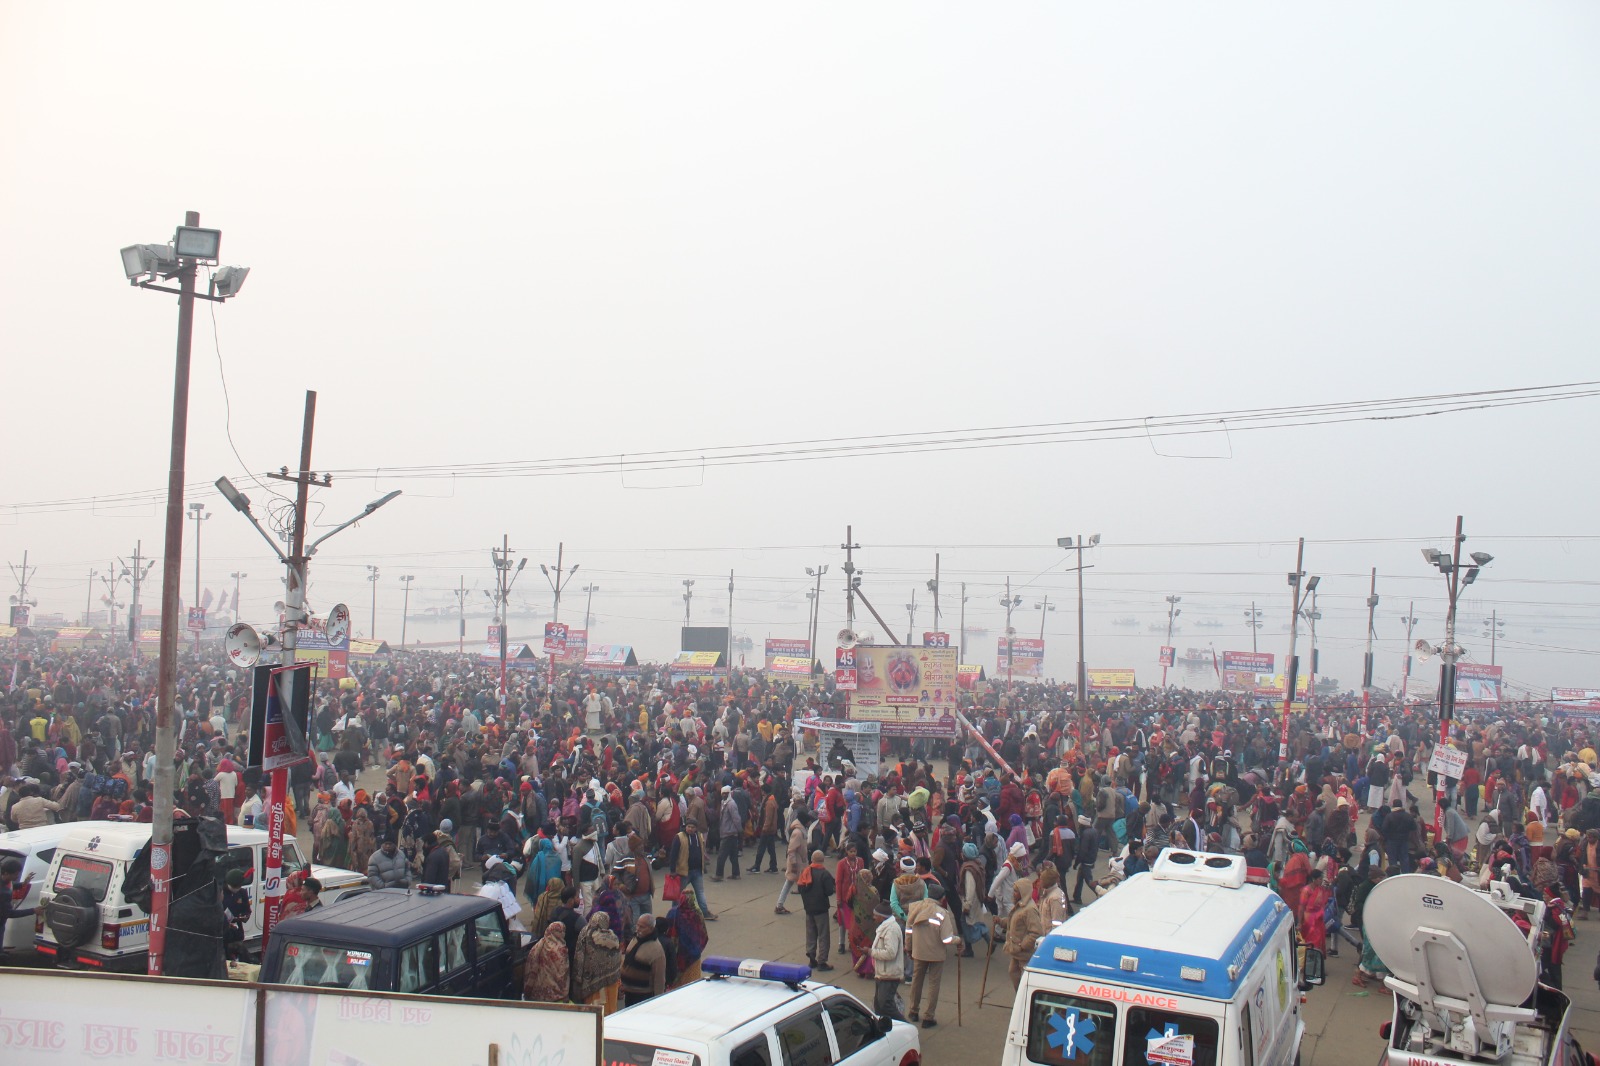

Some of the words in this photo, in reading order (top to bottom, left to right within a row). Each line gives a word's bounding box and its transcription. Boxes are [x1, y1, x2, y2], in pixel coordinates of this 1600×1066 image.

[550, 626, 565, 638] 32
[929, 635, 945, 647] 33
[839, 652, 853, 665] 45
[271, 802, 284, 841] यूनियन
[1076, 984, 1178, 1009] AMBULANCE
